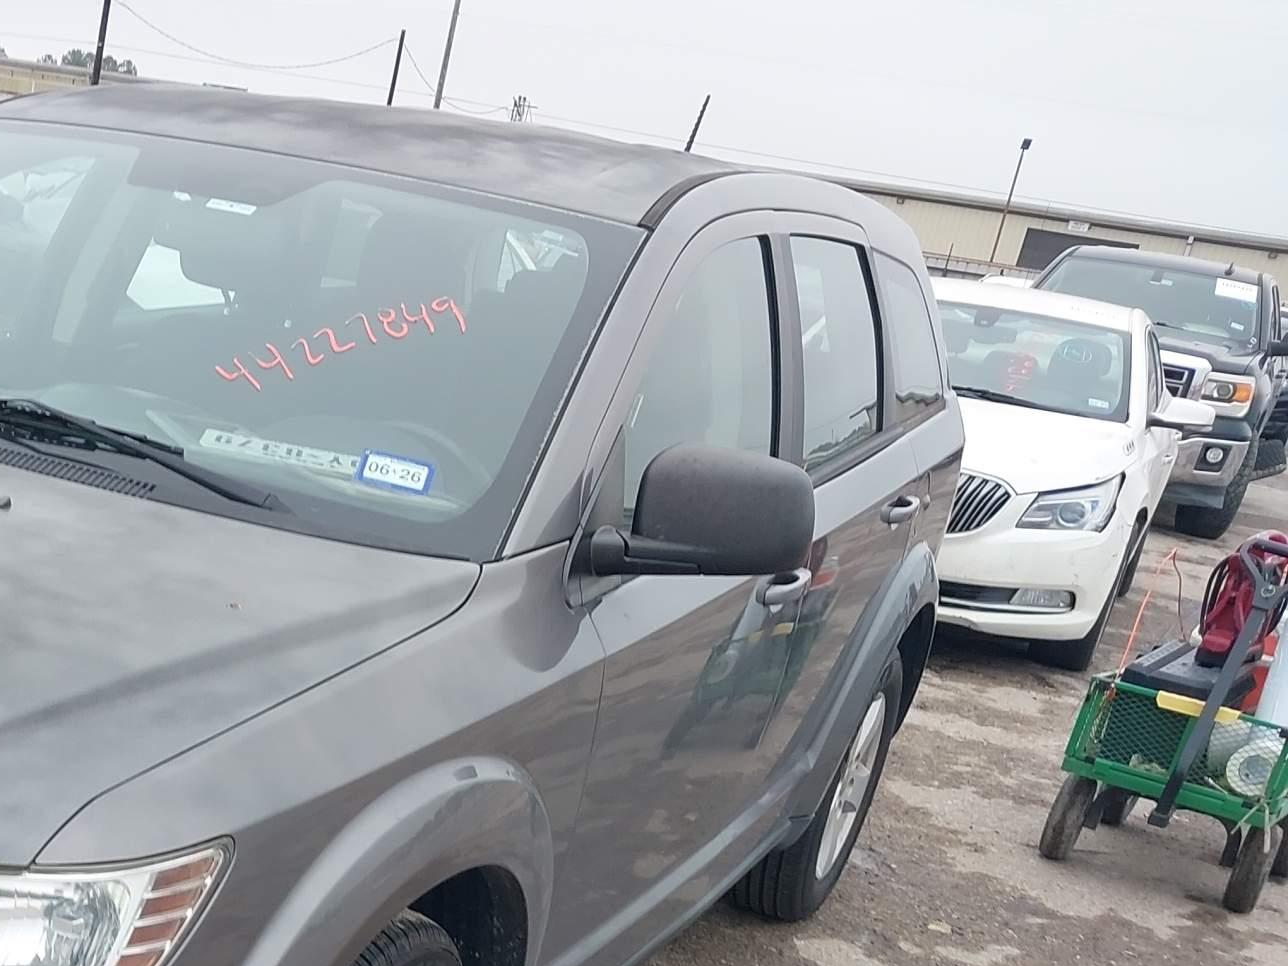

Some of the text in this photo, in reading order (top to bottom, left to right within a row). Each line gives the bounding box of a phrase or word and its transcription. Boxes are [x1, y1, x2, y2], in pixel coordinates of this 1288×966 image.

[215, 296, 466, 391] 44227849
[368, 461, 422, 484] 06 26
